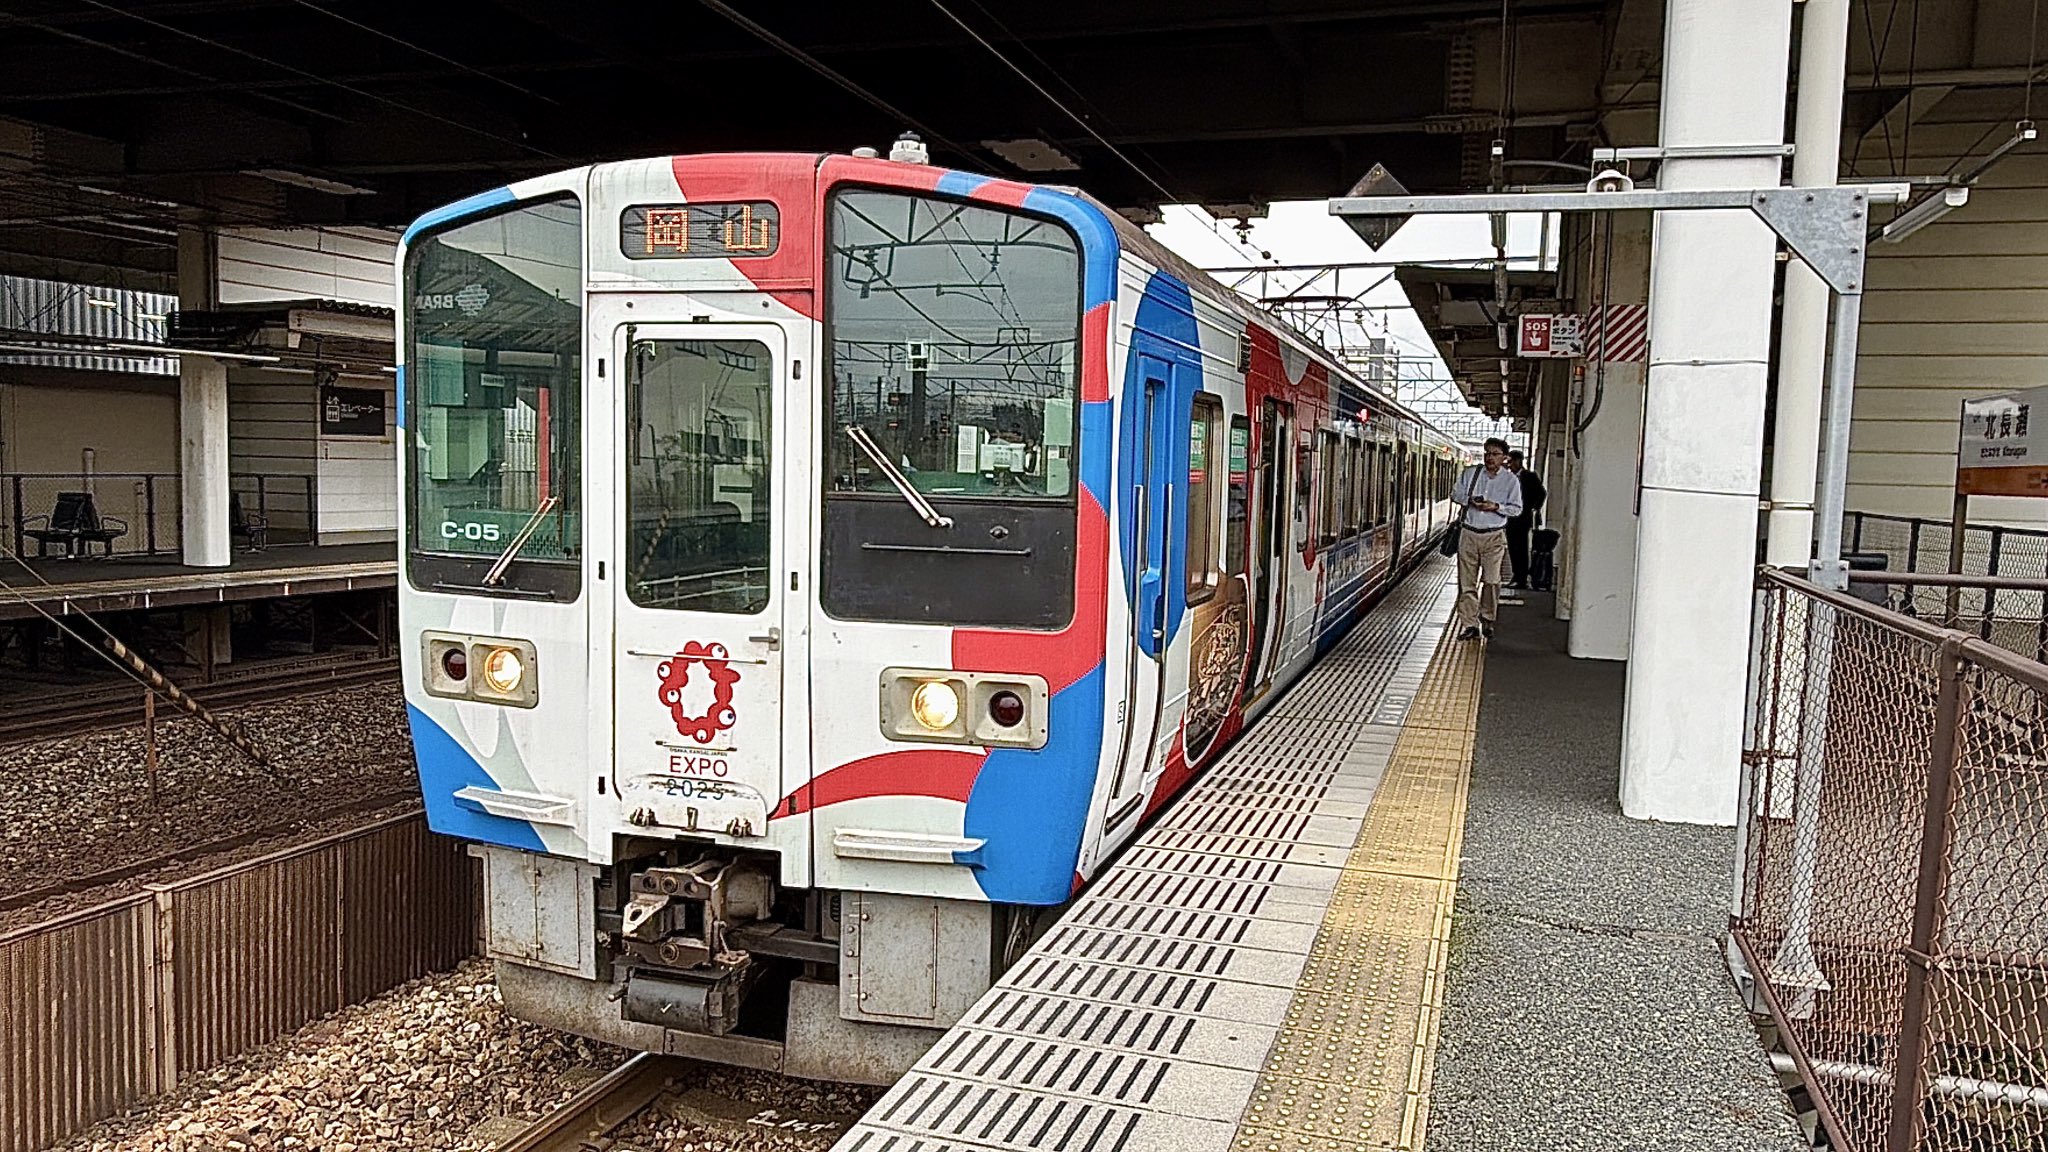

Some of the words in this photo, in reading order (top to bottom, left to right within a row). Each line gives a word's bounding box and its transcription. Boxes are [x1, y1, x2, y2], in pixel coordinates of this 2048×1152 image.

[647, 205, 769, 253] 岡山
[1525, 322, 1548, 331] SOS
[1518, 418, 1527, 430] 2
[441, 521, 500, 541] C-05
[670, 755, 728, 777] EXPO
[667, 778, 724, 801] 2025
